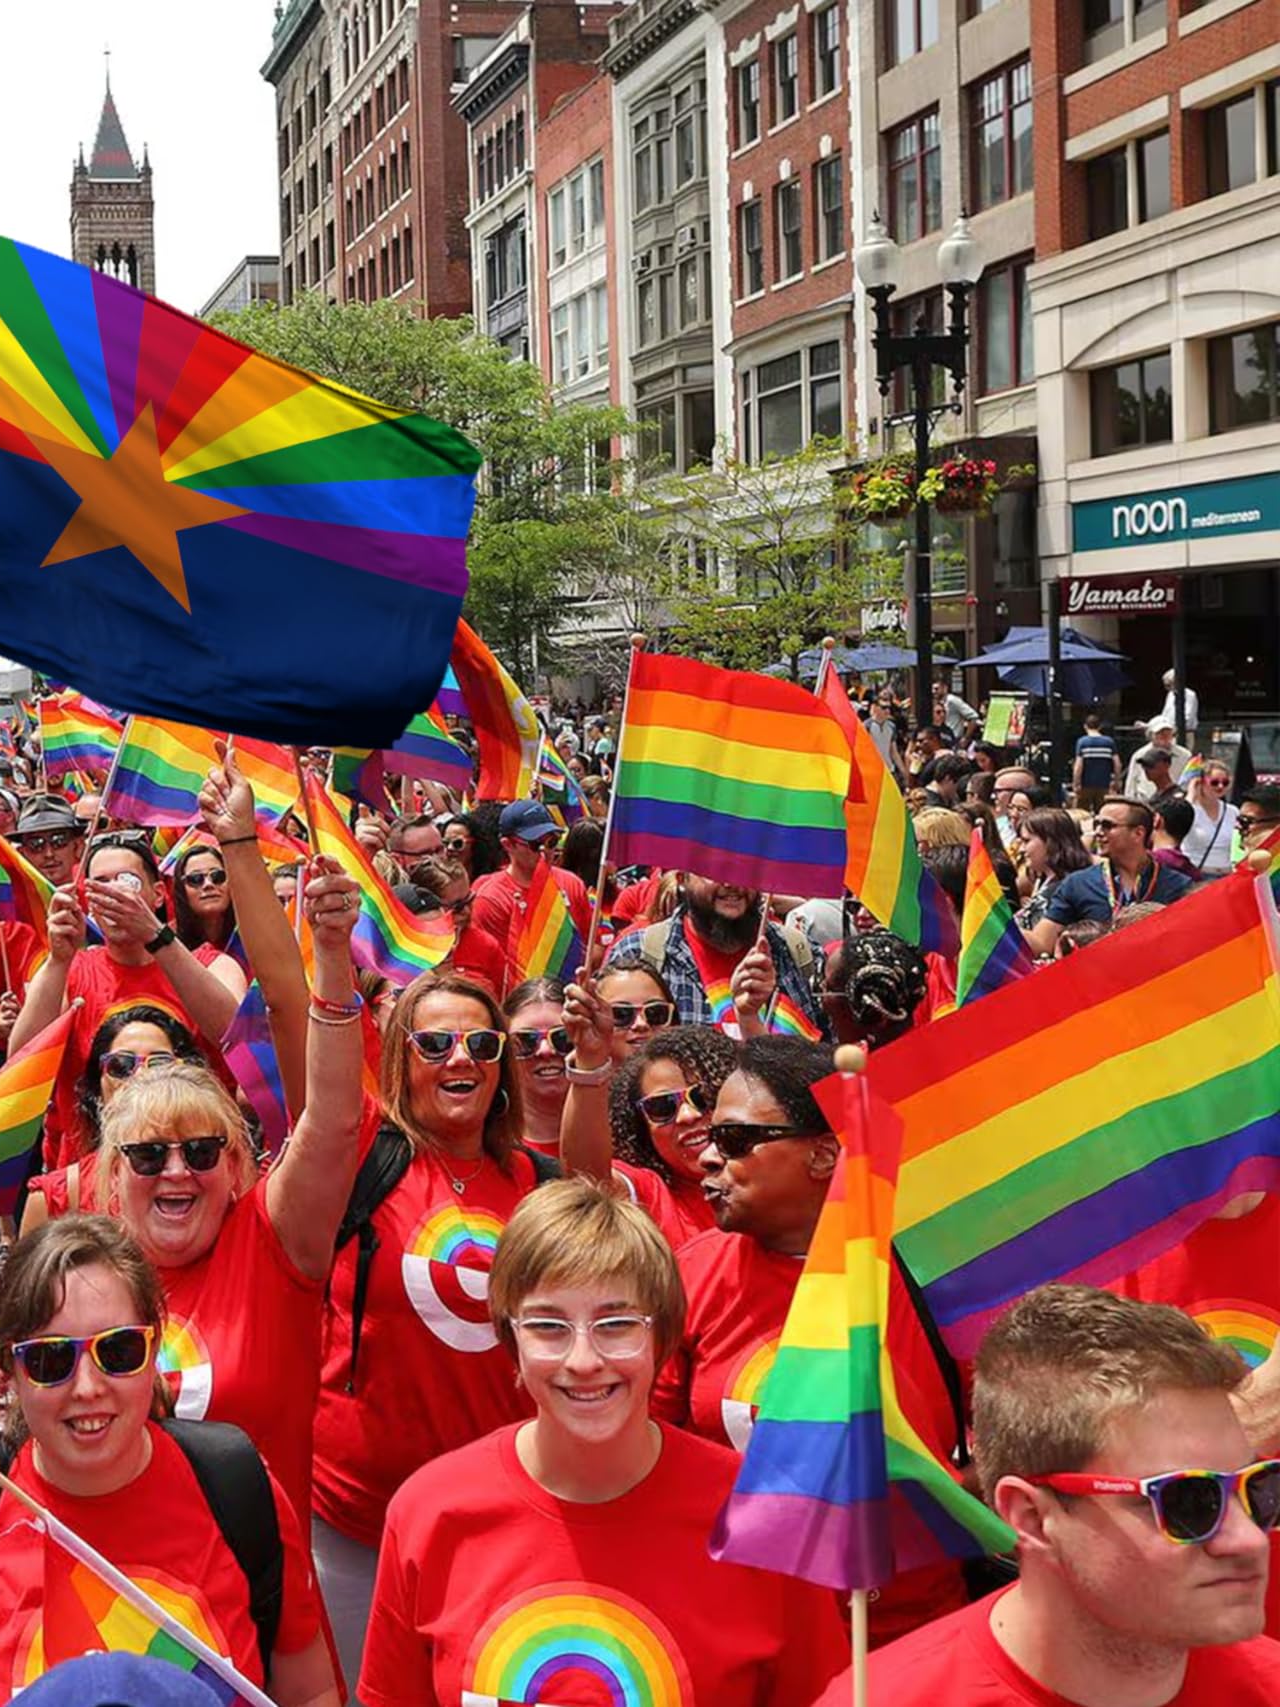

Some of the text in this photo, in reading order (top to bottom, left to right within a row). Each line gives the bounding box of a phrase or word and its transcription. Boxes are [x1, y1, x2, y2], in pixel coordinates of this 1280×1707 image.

[1113, 497, 1261, 538] noon mediterranean
[1068, 579, 1165, 612] Yamato
